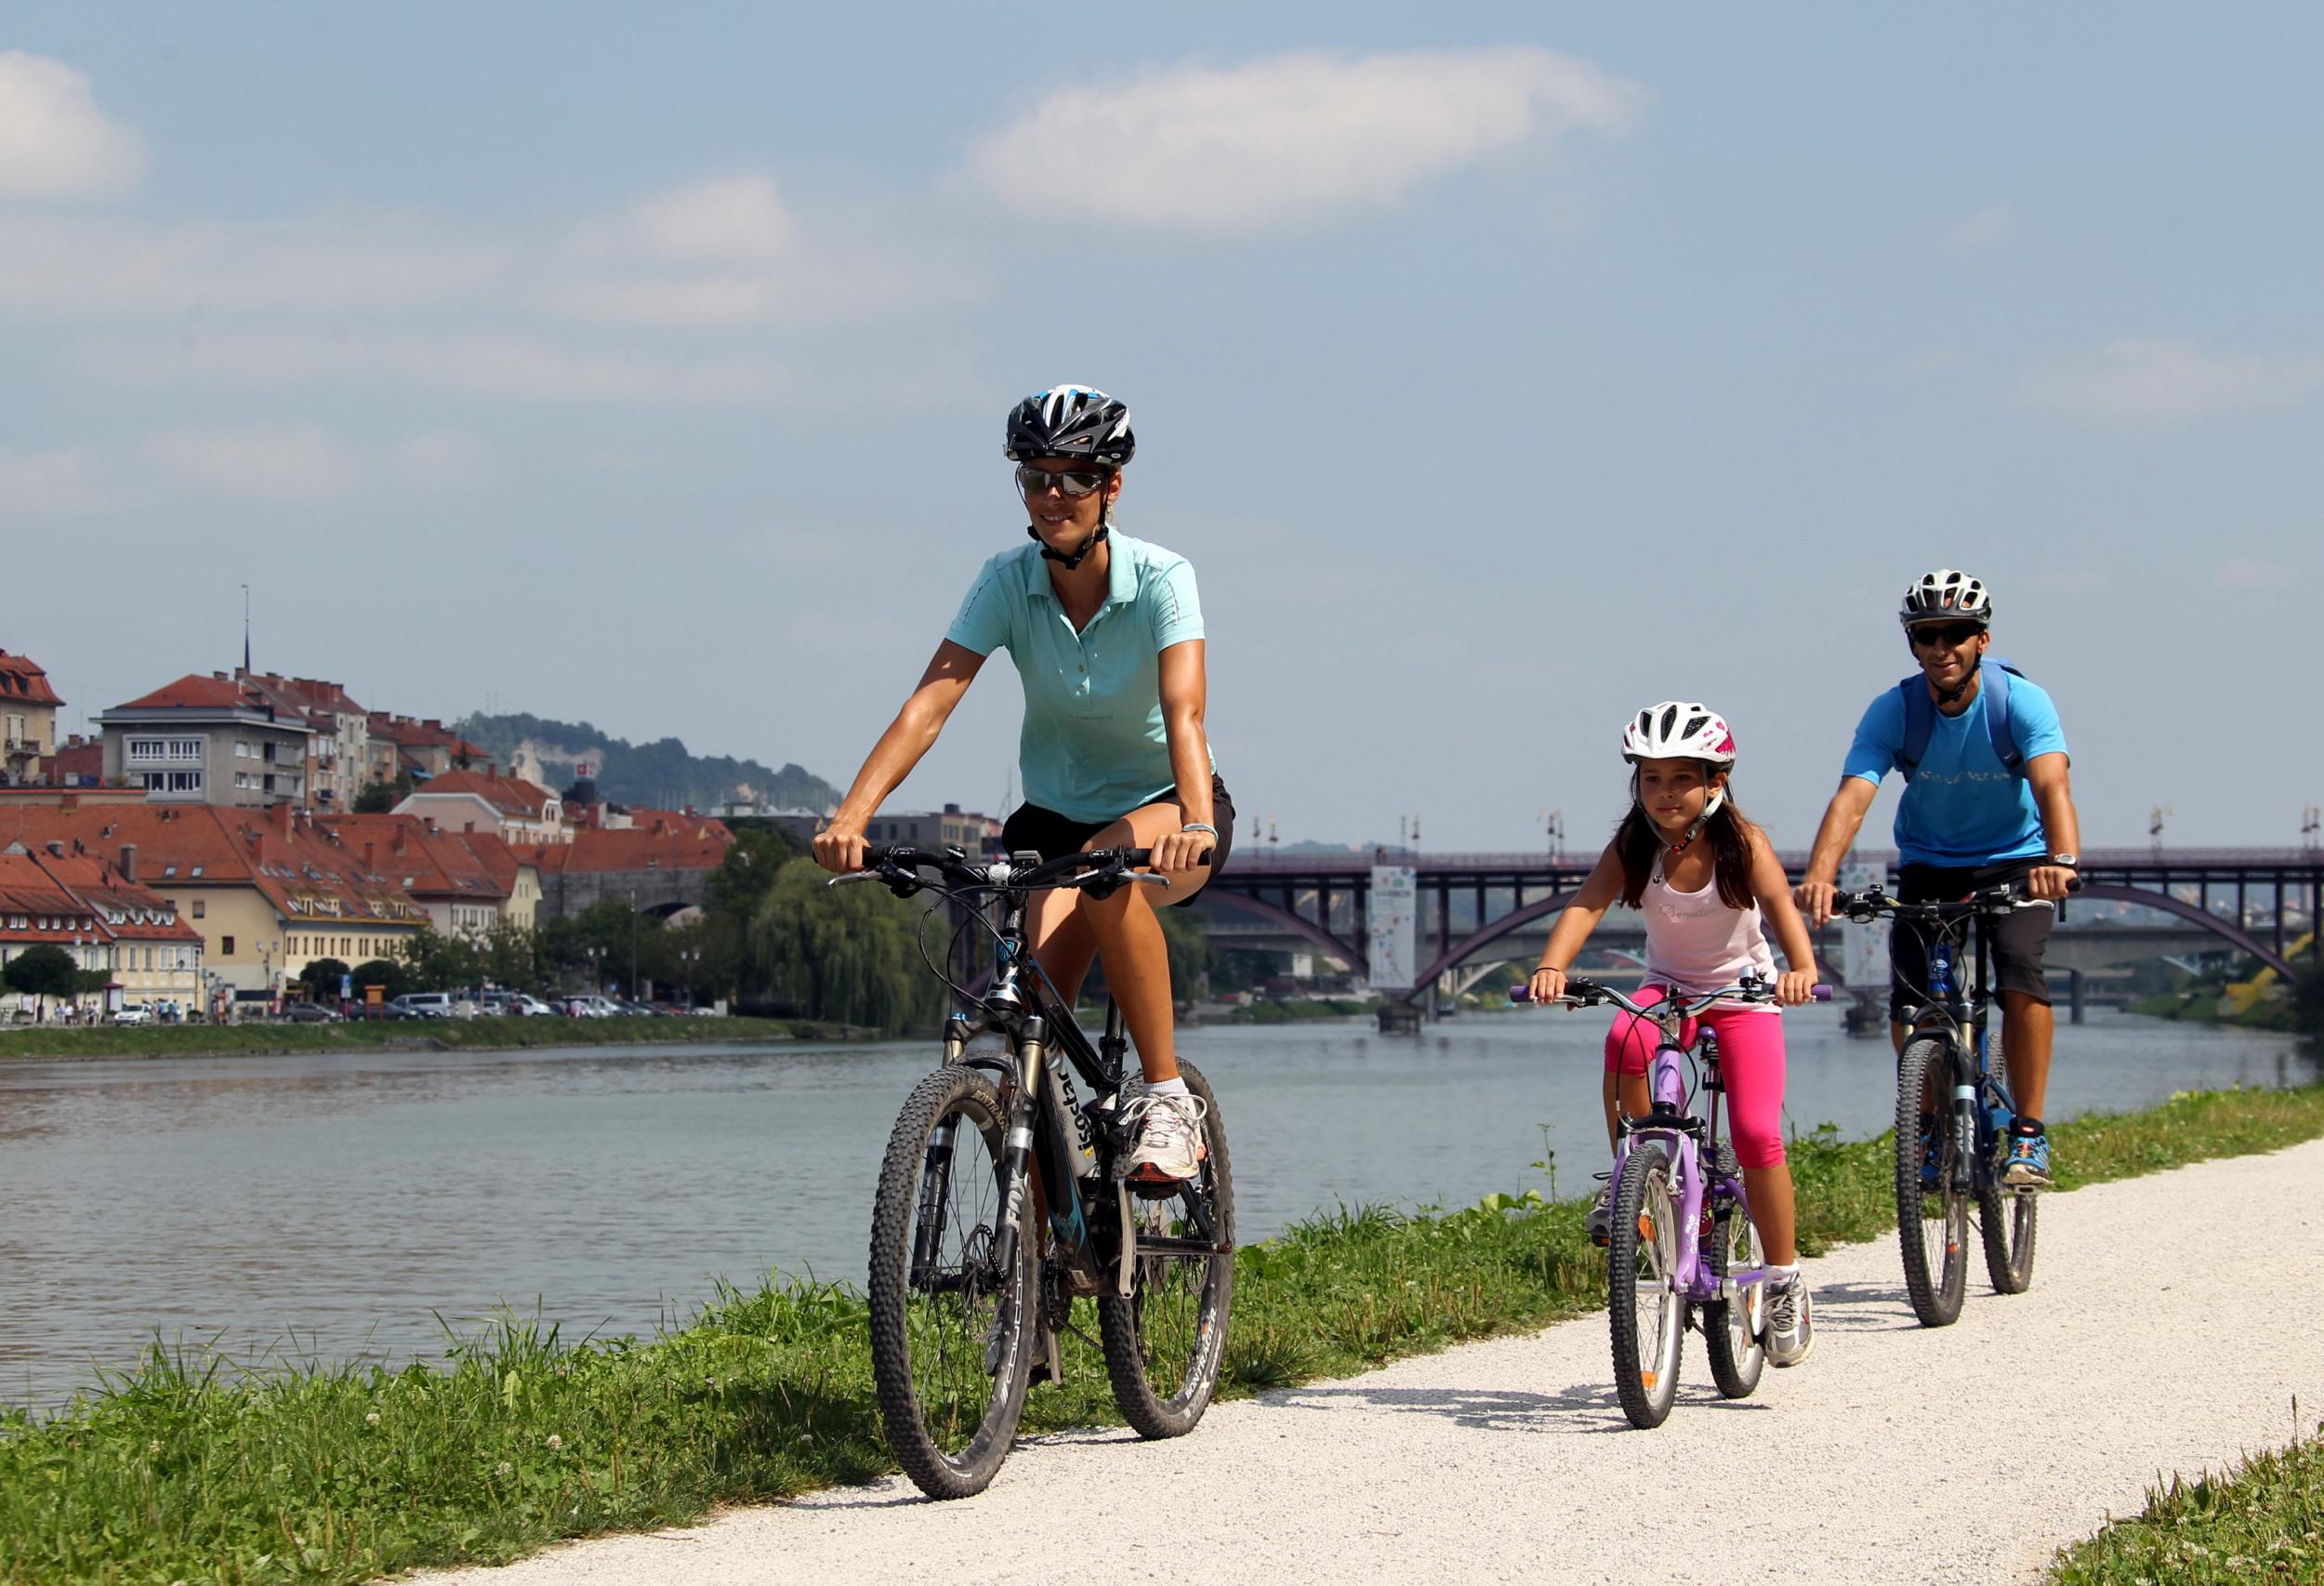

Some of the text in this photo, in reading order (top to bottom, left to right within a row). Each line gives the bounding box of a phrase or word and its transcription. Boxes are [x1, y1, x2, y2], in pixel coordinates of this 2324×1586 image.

[1058, 1072, 1094, 1151] isostar
[1005, 1167, 1025, 1234] FOX
[1184, 1305, 1218, 1400] BONTRAGER
